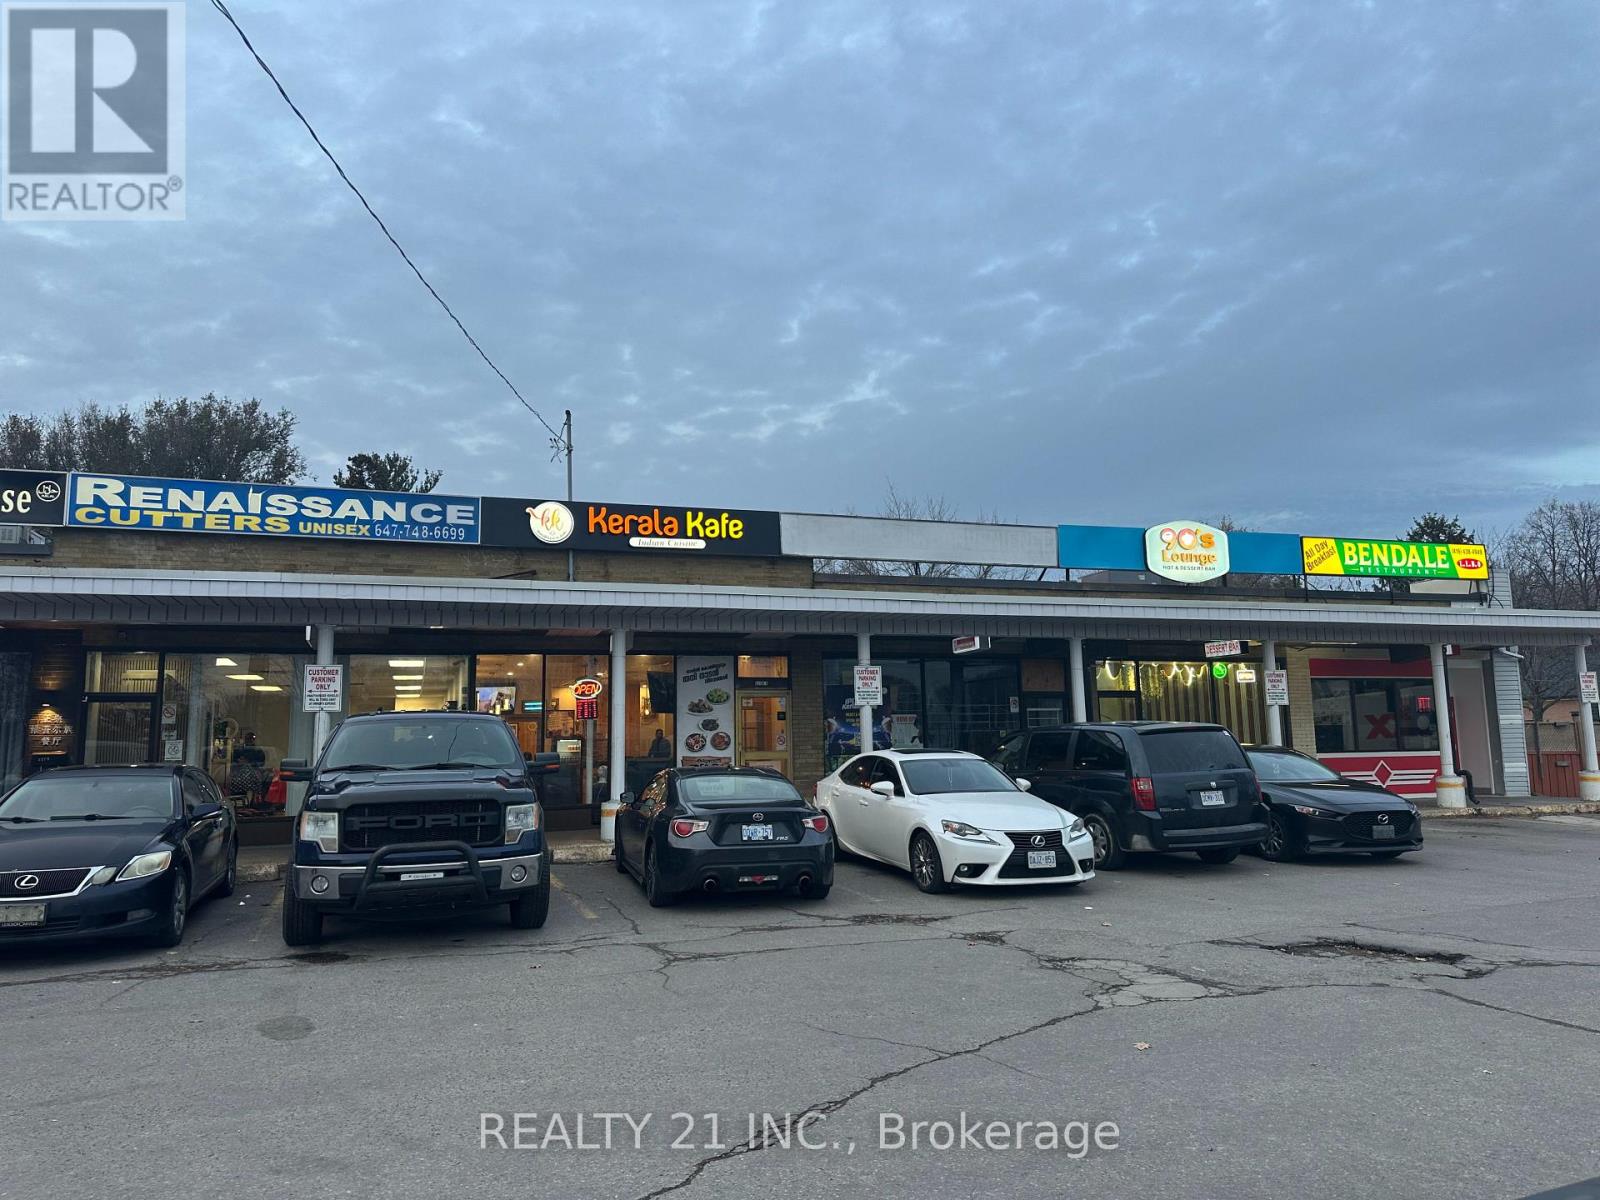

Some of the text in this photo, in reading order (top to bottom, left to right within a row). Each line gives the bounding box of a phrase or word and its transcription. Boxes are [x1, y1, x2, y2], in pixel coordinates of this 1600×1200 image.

[75, 476, 475, 526] RENAISSANCE
[75, 506, 291, 533] CUTTERS
[299, 521, 371, 537] UNISEX
[588, 506, 744, 539] Kerala Kafe
[1160, 527, 1216, 551] 90's
[1314, 540, 1329, 553] Day
[1162, 550, 1217, 566] Lounge
[1306, 546, 1337, 571] Breakfast
[1342, 542, 1452, 570] BENDALE
[1205, 643, 1228, 654] DESSERT
[574, 683, 599, 695] OPEN
[344, 813, 499, 832] FORD
